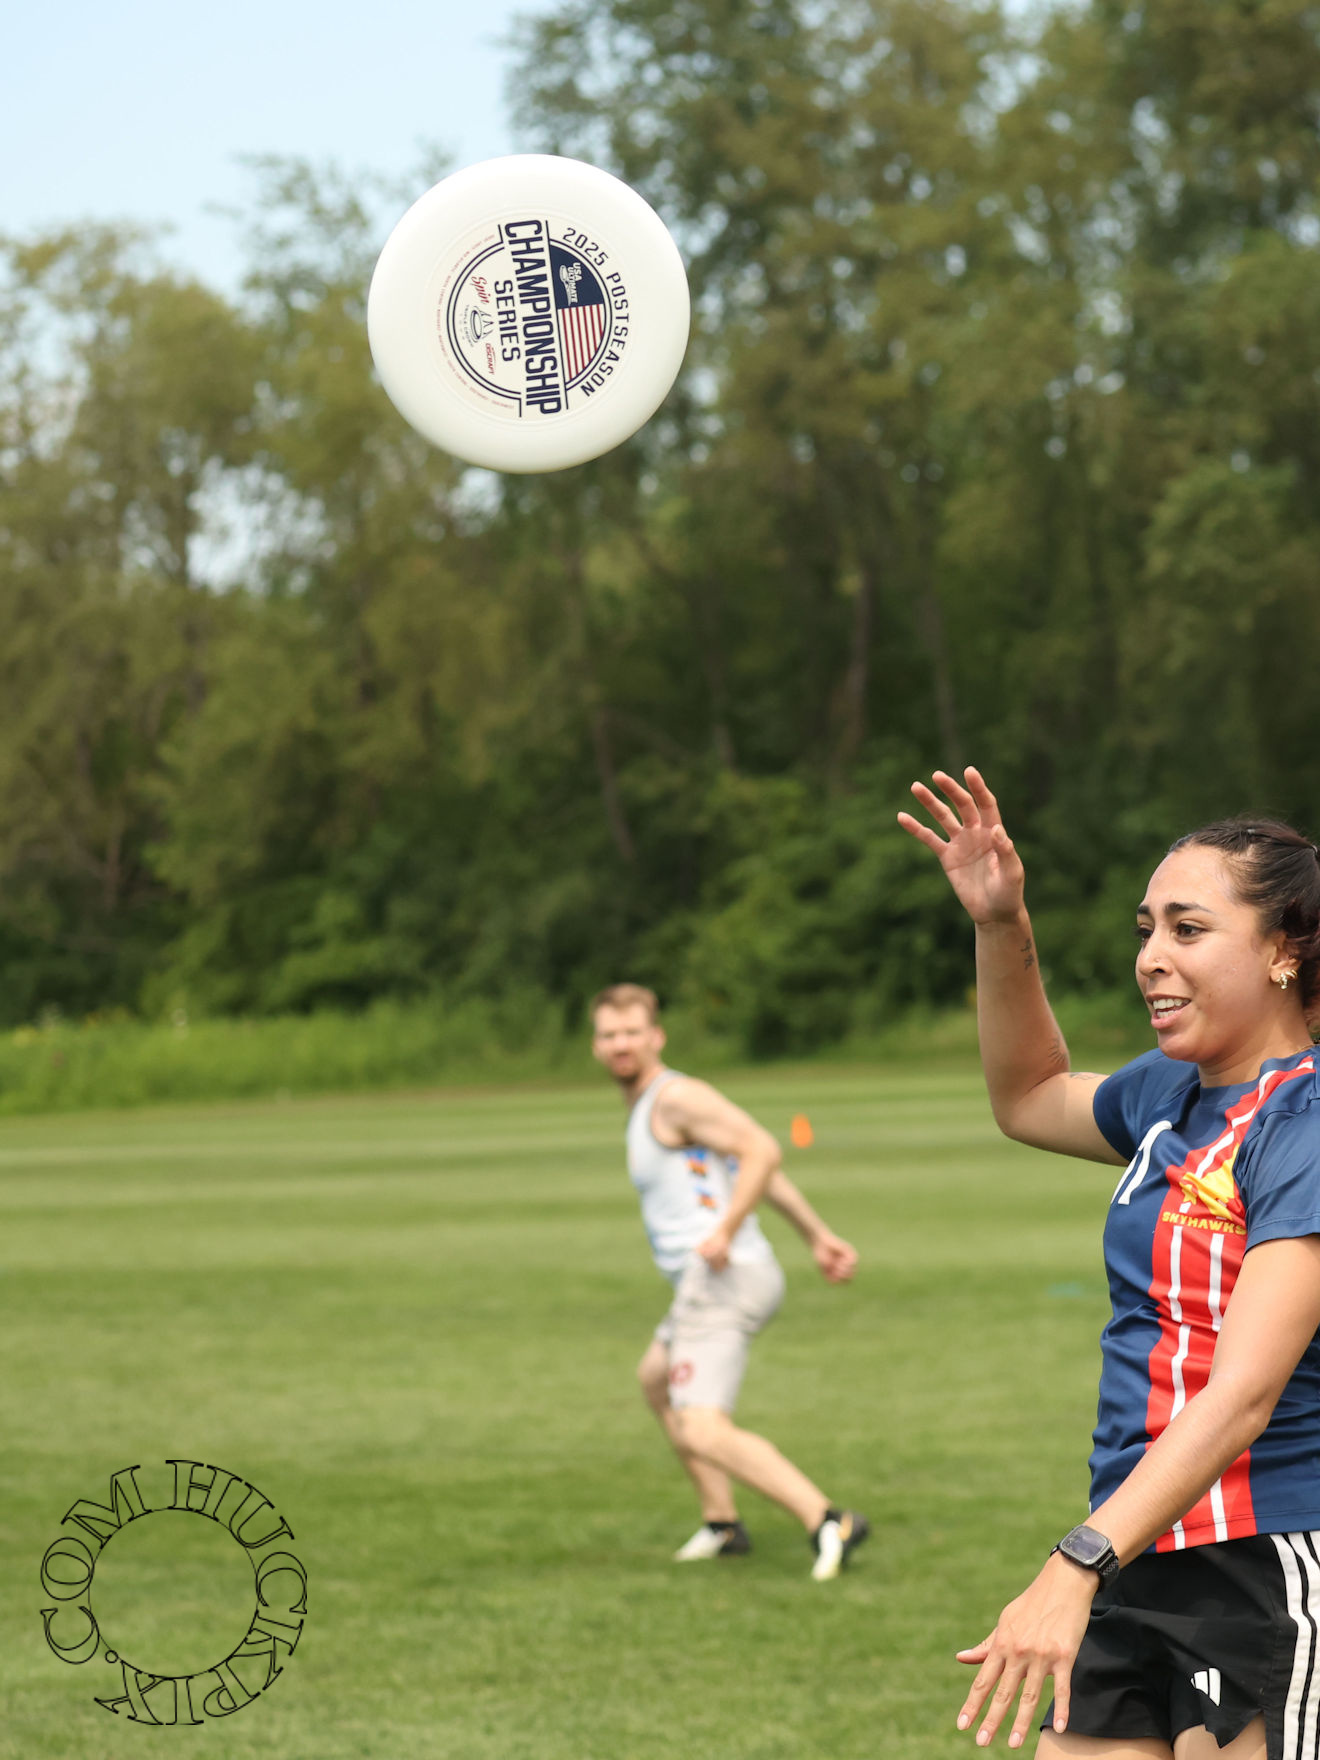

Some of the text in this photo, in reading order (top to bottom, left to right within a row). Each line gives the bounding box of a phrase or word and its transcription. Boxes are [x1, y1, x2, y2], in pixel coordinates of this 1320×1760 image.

[469, 276, 491, 304] Spin
[567, 266, 578, 303] ULTIMATE
[573, 262, 582, 281] USA
[494, 279, 521, 362] SERIES
[504, 219, 562, 415] CHAMPIONSHIP
[562, 227, 630, 397] 2025 POSTSEASON
[1162, 1211, 1247, 1235] SKYHAWKS
